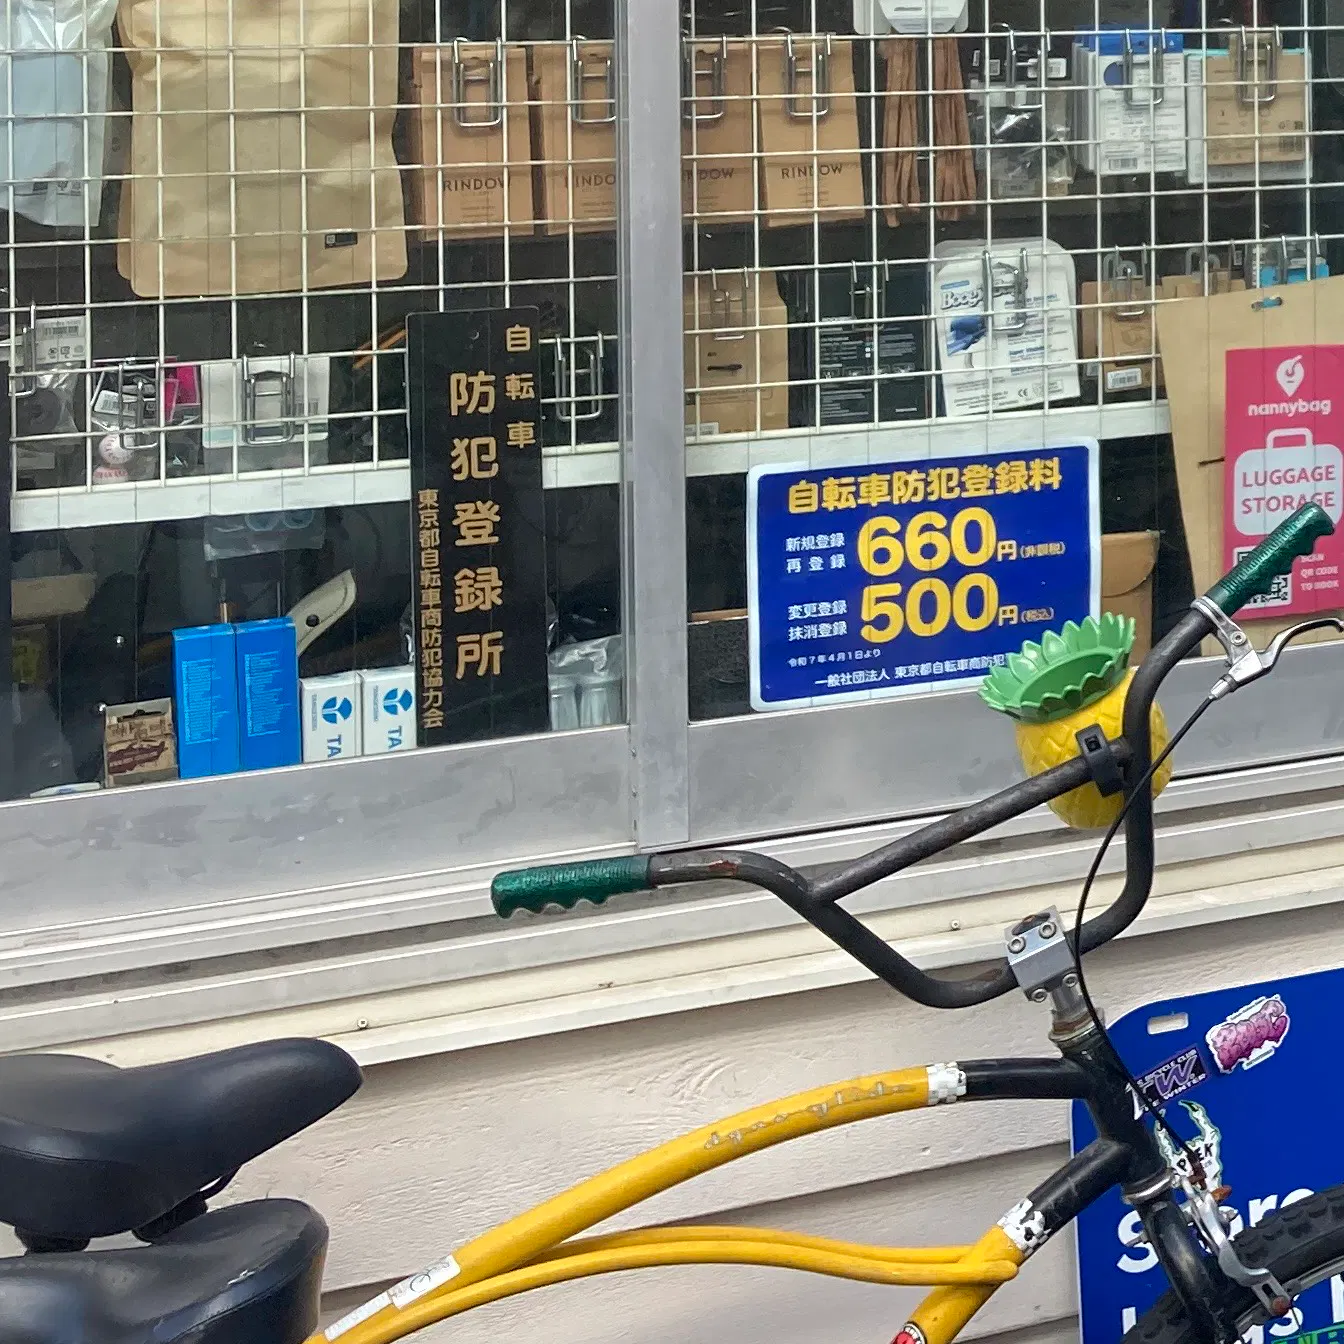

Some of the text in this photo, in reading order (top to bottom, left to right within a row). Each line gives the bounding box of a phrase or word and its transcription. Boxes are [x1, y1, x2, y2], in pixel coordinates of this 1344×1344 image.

[505, 324, 536, 449] 自転車
[1248, 398, 1332, 417] nannybag
[788, 457, 1062, 513] 自転車防犯登録料
[1241, 464, 1336, 488] LUGGAGE
[1241, 491, 1336, 515] STORAGE
[450, 370, 504, 680] 防犯登録所
[785, 532, 846, 552] 新規登録
[1301, 566, 1338, 578] QR CODE
[417, 489, 444, 728] 東京都自転車商防犯協力会
[788, 600, 847, 621] 変更登録
[788, 621, 848, 642] 抹消登録
[327, 734, 342, 758] TA
[387, 725, 403, 750] TA
